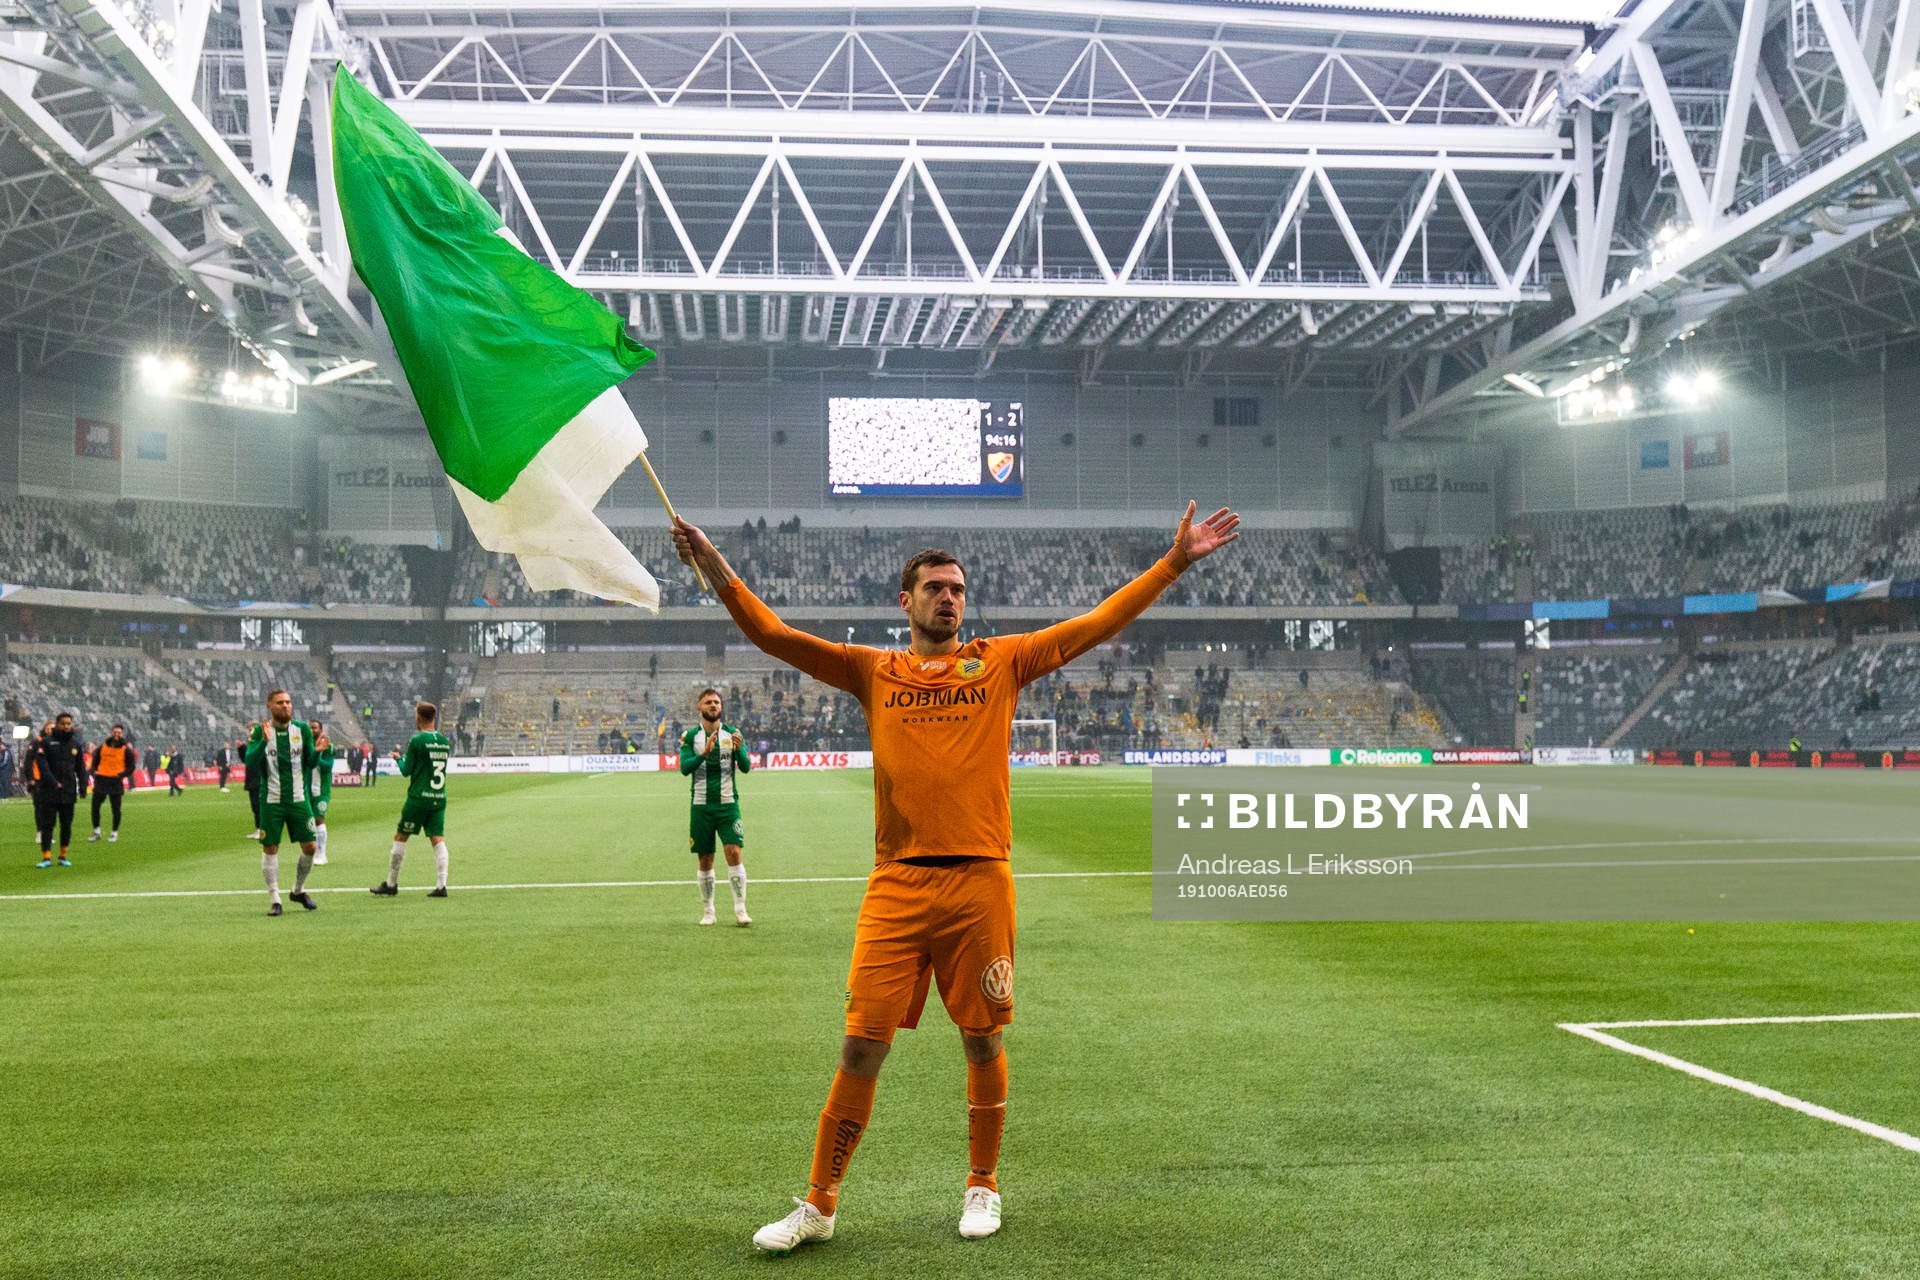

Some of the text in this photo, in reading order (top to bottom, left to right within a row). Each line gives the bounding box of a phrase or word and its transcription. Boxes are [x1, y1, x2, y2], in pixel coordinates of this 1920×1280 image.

[985, 413, 992, 426] 1
[1007, 412, 1017, 426] 2
[985, 433, 1017, 446] 94:16
[336, 466, 388, 487] TELE2
[1390, 473, 1488, 493] TELE2 Arena
[884, 687, 986, 708] JOBMAN
[902, 715, 969, 723] WORKWEAR
[586, 756, 640, 764] OUAZZANI
[771, 753, 849, 768] MAXXIS
[1124, 751, 1221, 763] ERLANDSSON
[1357, 751, 1422, 764] Rekomo
[1433, 752, 1519, 762] OLKA SPORTRESOR
[430, 760, 445, 790] 3
